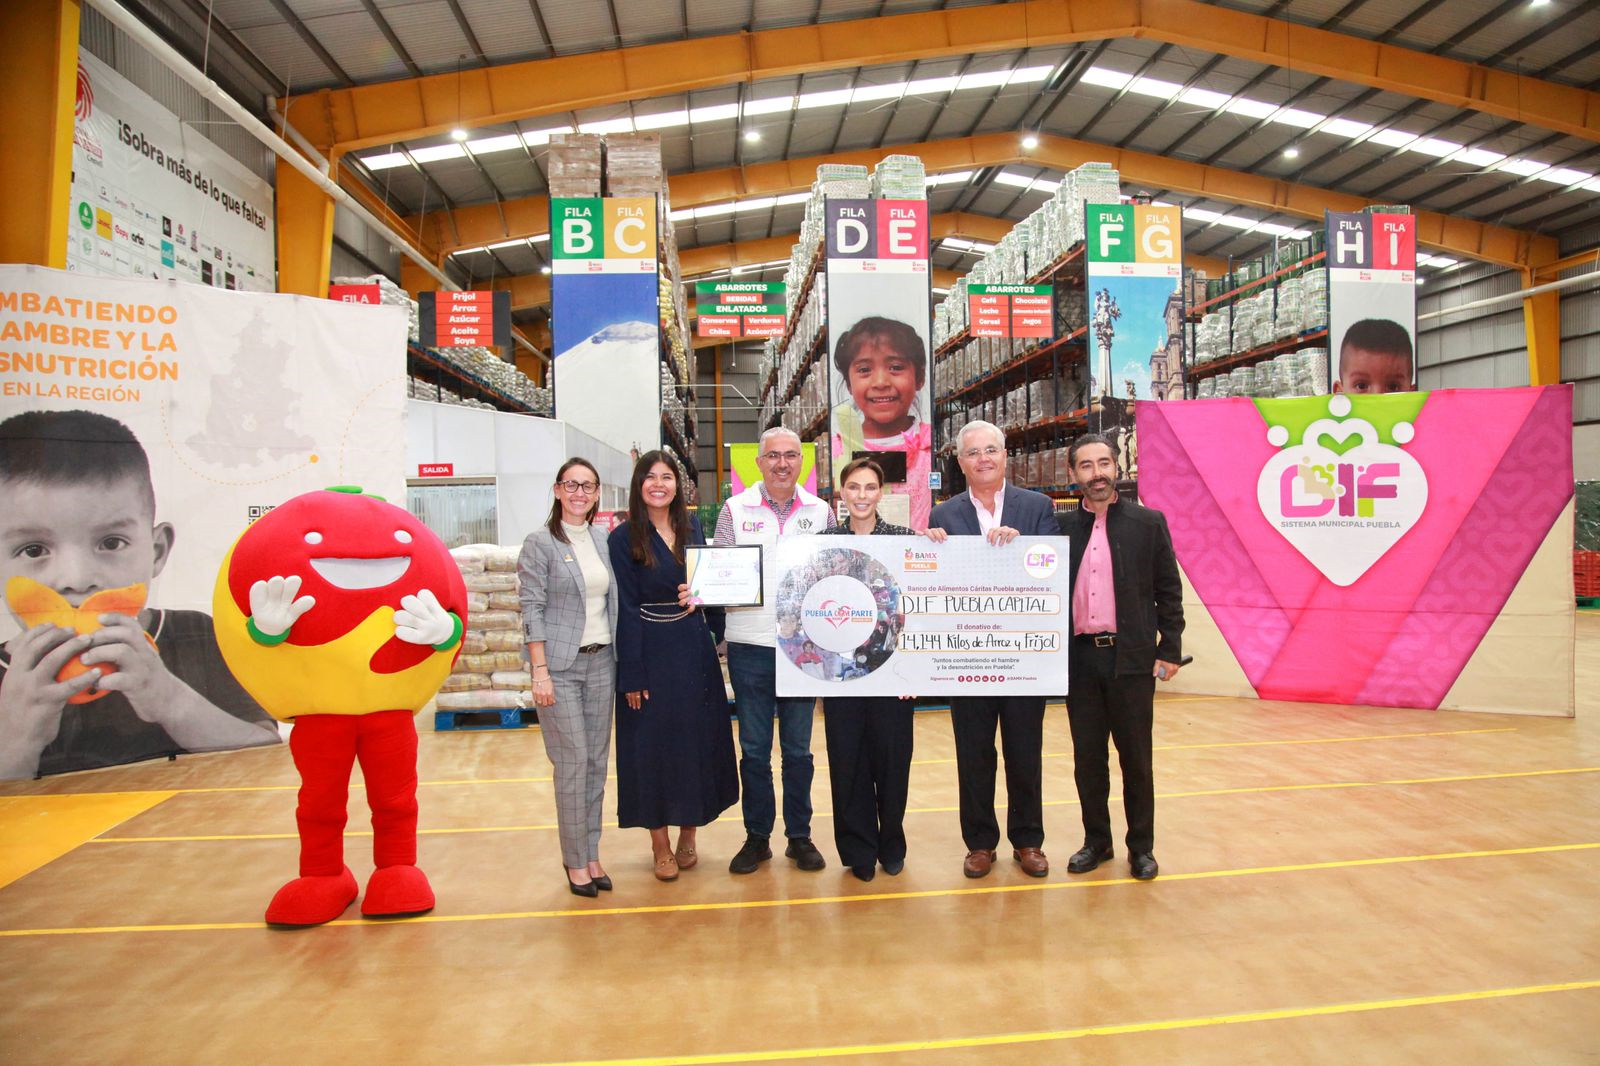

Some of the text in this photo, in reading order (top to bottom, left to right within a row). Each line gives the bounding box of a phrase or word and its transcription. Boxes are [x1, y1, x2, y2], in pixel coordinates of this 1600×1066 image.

[167, 156, 192, 184] más
[195, 171, 208, 194] de
[210, 179, 220, 201] lo
[222, 192, 240, 215] que
[242, 201, 266, 231] falta!
[565, 208, 591, 217] FILA
[618, 208, 644, 217] FILA
[840, 208, 866, 217] FILA
[890, 209, 916, 218] FILA
[1100, 213, 1124, 223] FILA
[1146, 215, 1169, 224] FILA
[1340, 221, 1362, 230] FILA
[1384, 223, 1406, 232] FILA
[563, 219, 593, 254] B
[614, 218, 646, 254] C
[837, 219, 868, 253] D
[889, 220, 917, 254] E
[1100, 224, 1124, 257] F
[1142, 224, 1173, 259] G
[1337, 231, 1363, 264] H
[1391, 233, 1398, 265] I
[342, 294, 369, 304] FILA
[453, 293, 475, 302] Frijol
[0, 321, 177, 352] AMBRE Y LA
[455, 337, 475, 345] Soya
[4, 382, 141, 402] EN LA REGIÓN
[1280, 457, 1400, 518] DIF
[946, 596, 995, 612] PUEBLA
[999, 597, 1052, 612] CAPITAL
[948, 634, 970, 650] Kilos
[972, 636, 984, 648] de
[1015, 640, 1021, 650] y
[1025, 633, 1055, 652] Frijol
